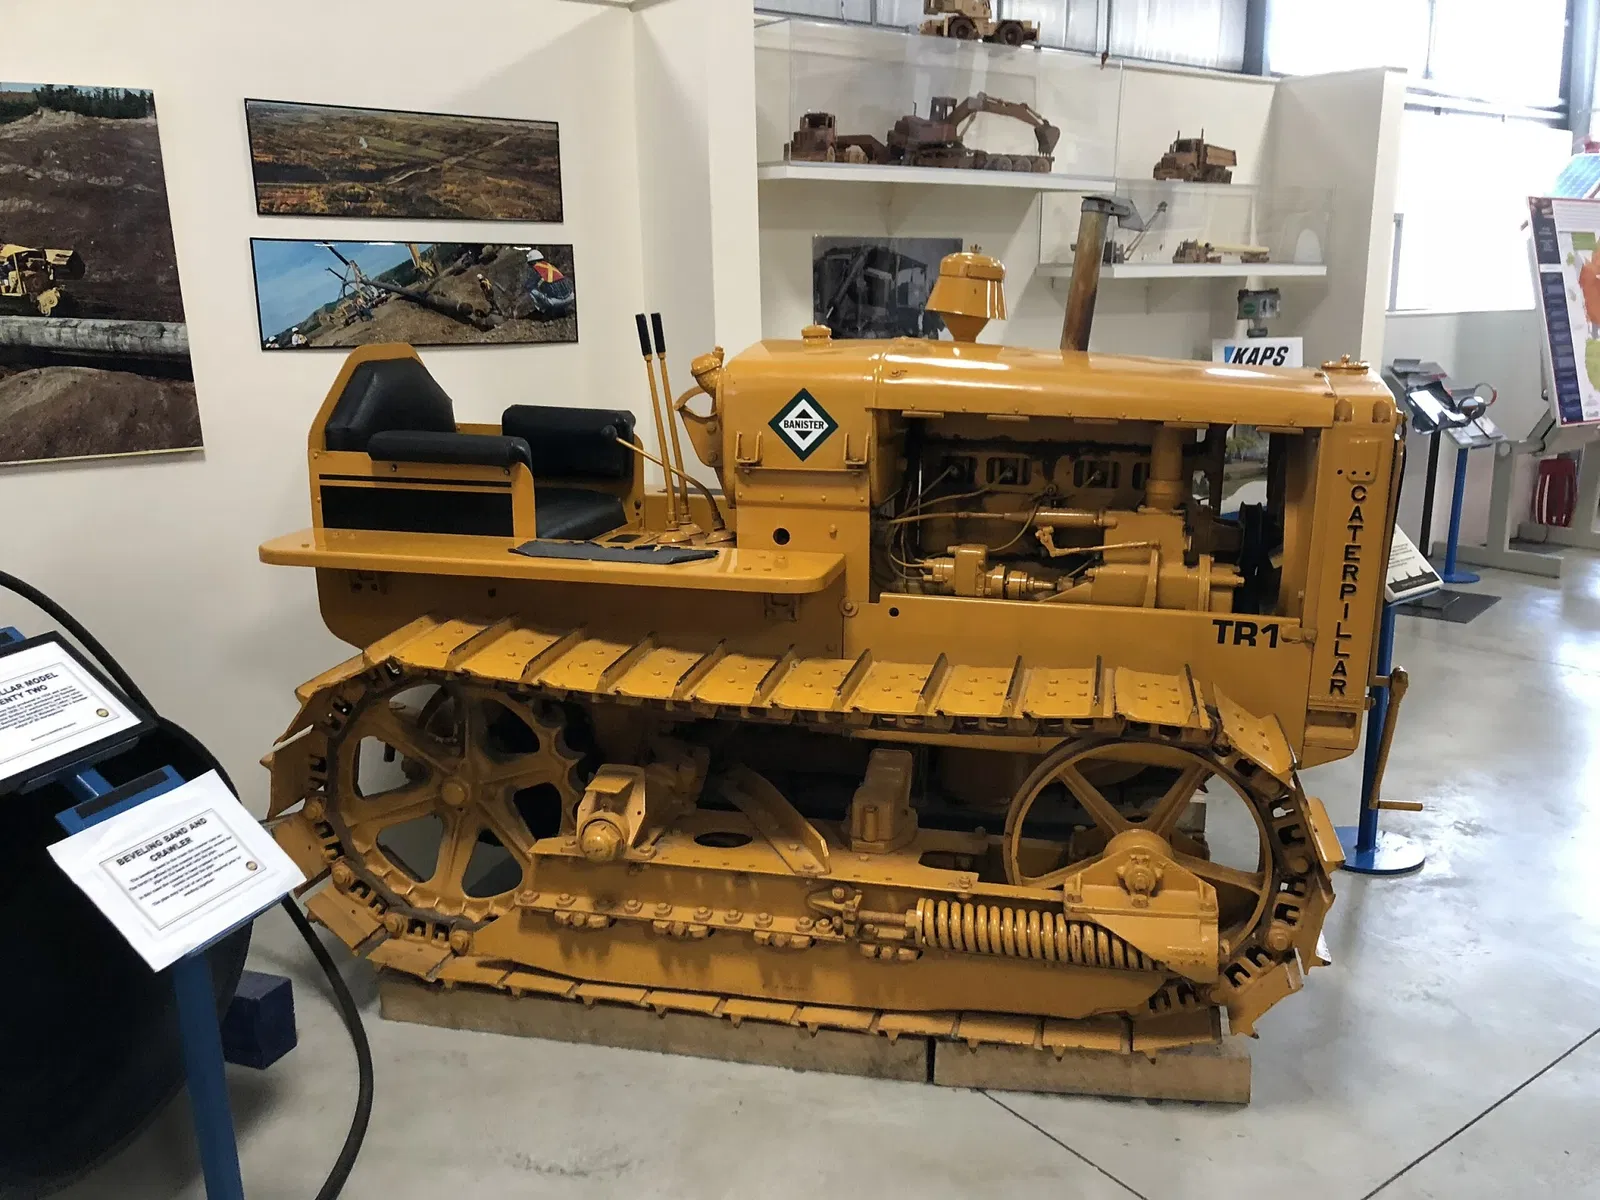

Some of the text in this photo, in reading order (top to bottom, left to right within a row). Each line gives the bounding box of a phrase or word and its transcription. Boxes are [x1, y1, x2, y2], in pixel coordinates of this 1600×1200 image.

[1232, 346, 1289, 366] KAPS
[783, 420, 824, 430] BANISTER
[1329, 485, 1367, 695] CATERPILLAR
[1212, 619, 1279, 648] TR1
[24, 672, 59, 687] MODEL
[25, 684, 48, 695] TWO
[116, 817, 207, 866] BEVELING BAND AND
[149, 836, 193, 862] CRAWLER
